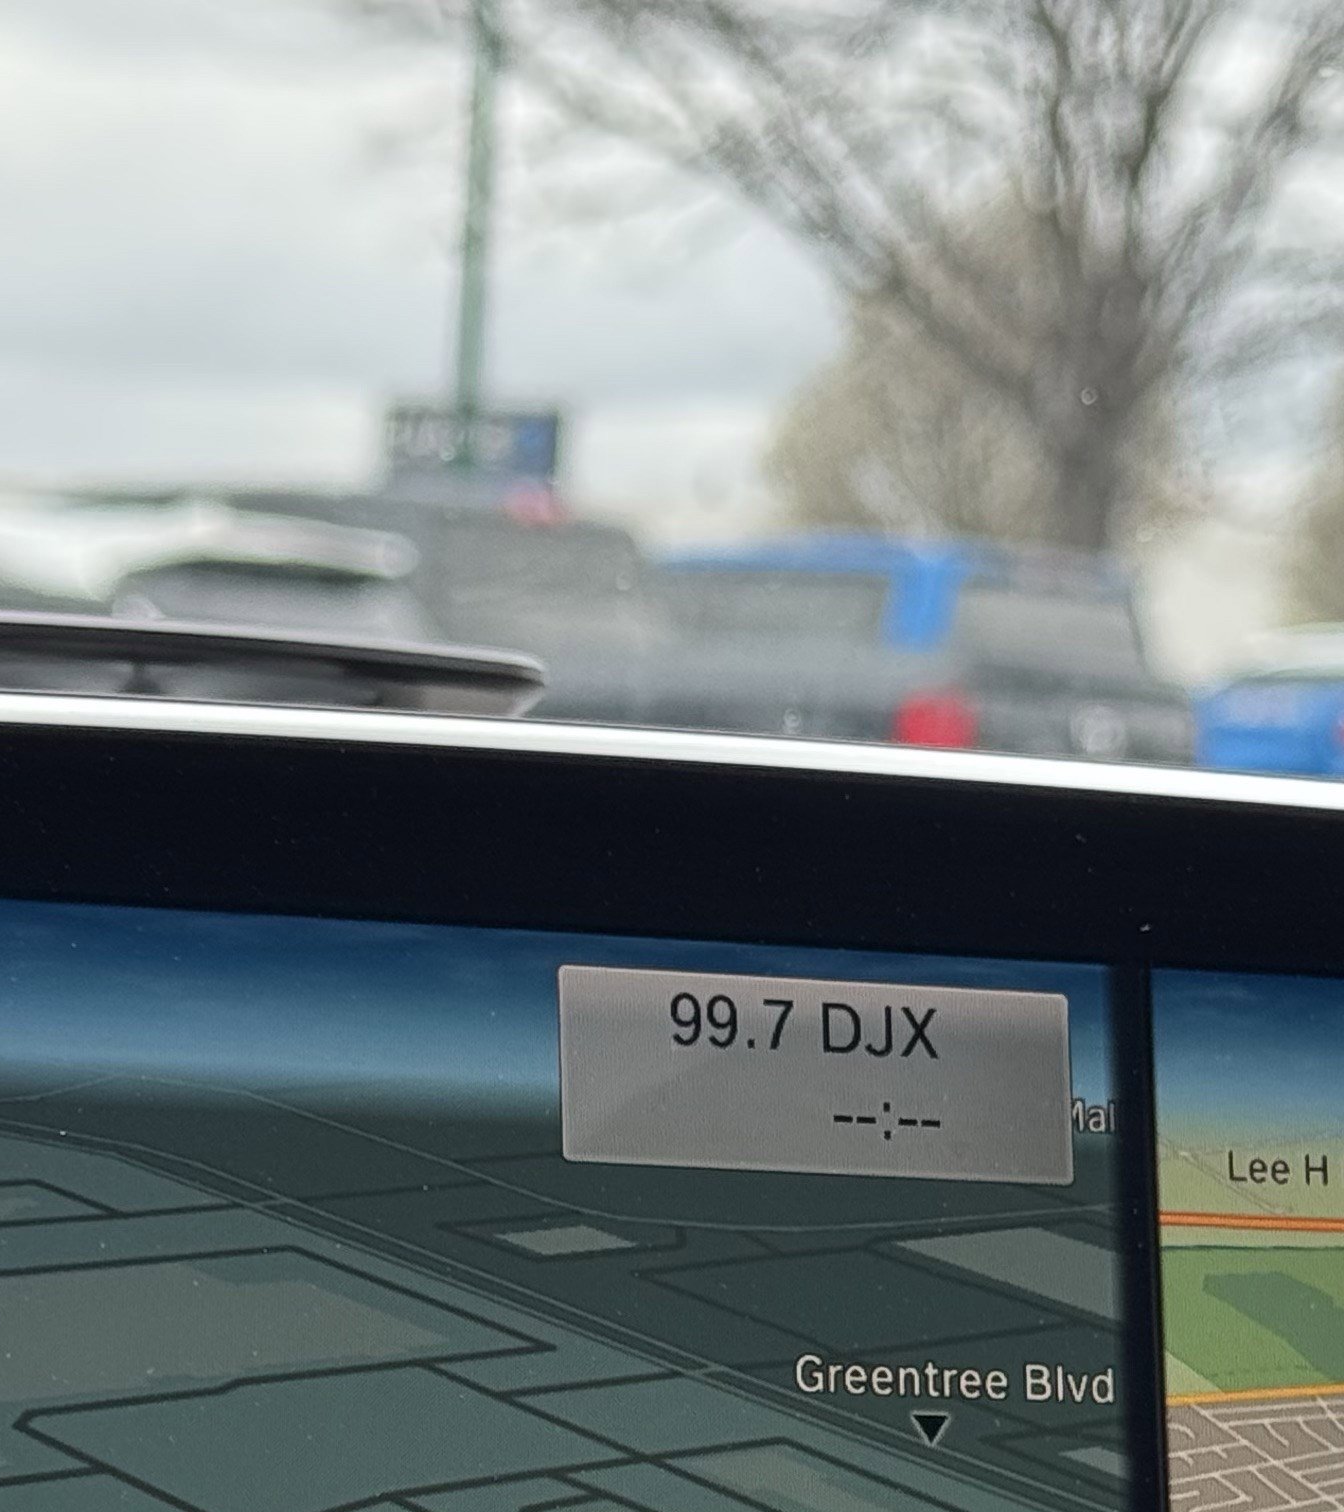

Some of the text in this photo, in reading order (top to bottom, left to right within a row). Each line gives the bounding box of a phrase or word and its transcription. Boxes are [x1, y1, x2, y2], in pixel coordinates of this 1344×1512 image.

[670, 992, 940, 1060] 99.7 DJX
[1227, 1149, 1291, 1185] Lee
[1304, 1153, 1329, 1187] H
[794, 1353, 1116, 1405] Greentree Blvd
